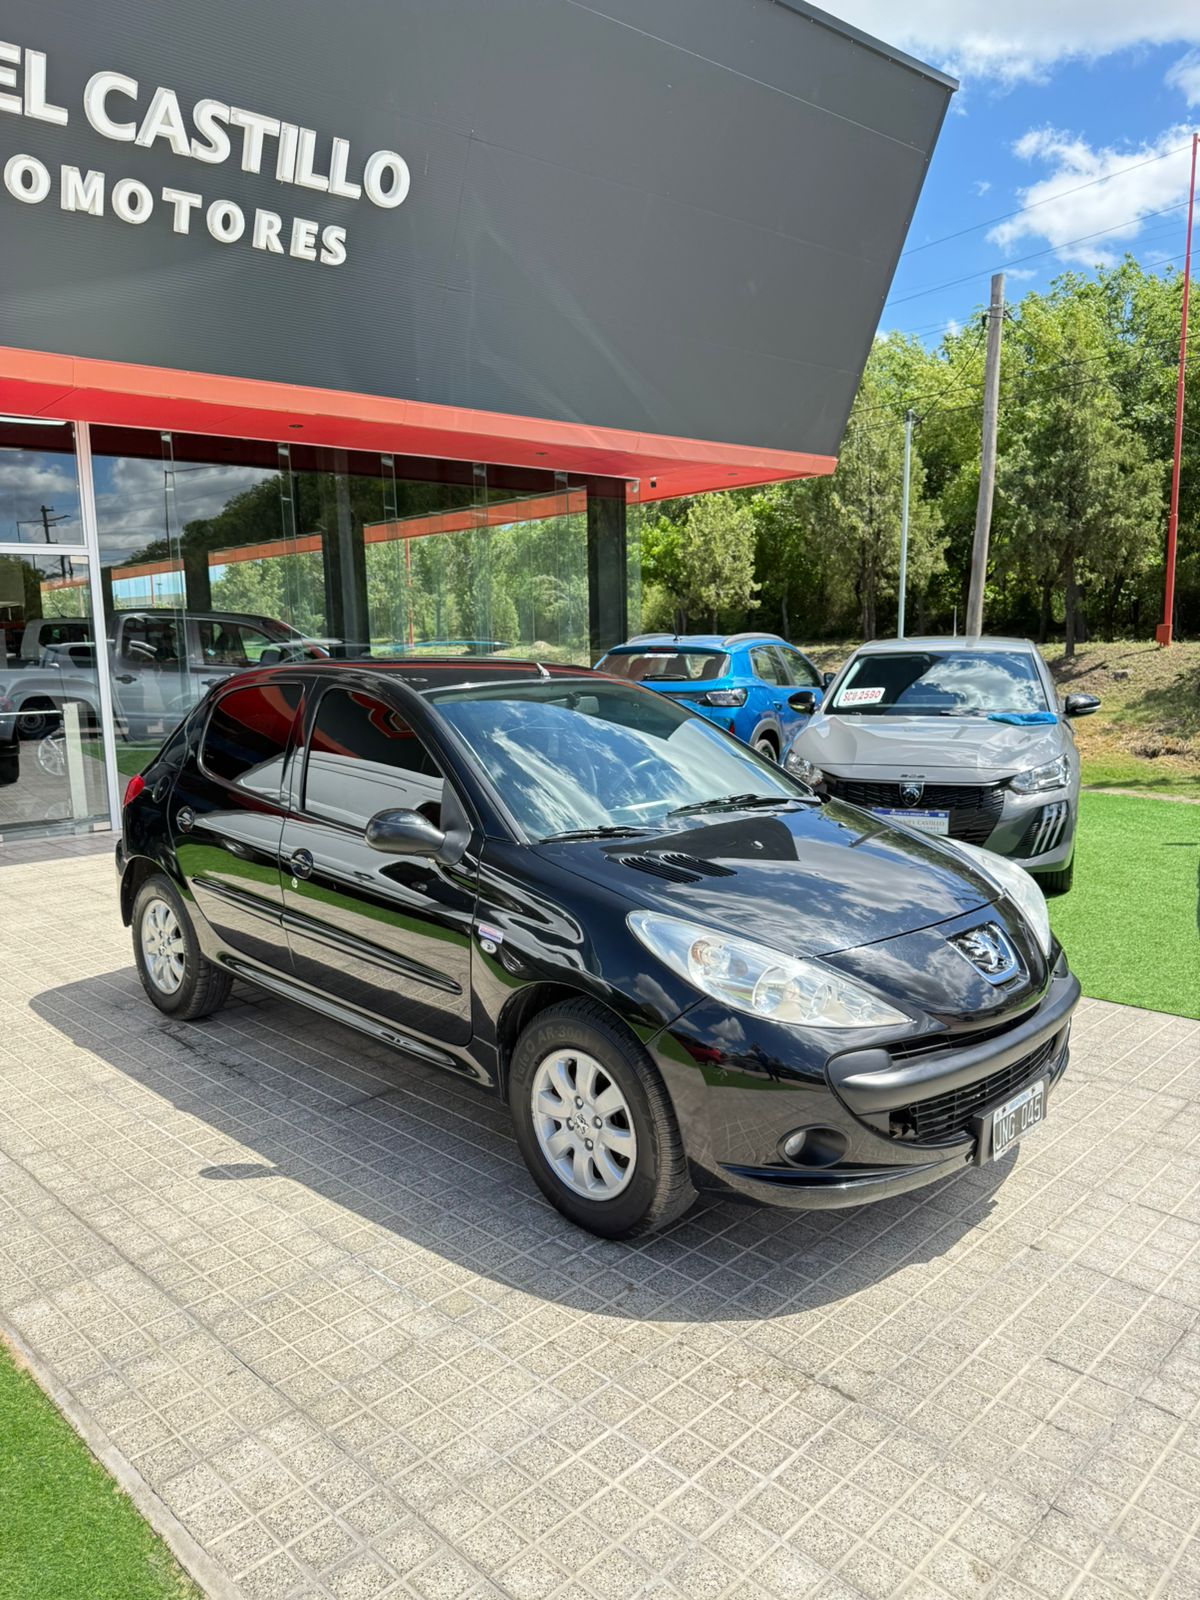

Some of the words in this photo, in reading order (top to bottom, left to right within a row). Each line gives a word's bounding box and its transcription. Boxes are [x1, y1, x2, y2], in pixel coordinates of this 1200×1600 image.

[84, 71, 411, 208] CASTILLO
[4, 153, 347, 266] OMOTORES
[995, 1112, 1015, 1150] JNG
[1021, 1095, 1041, 1130] 045
